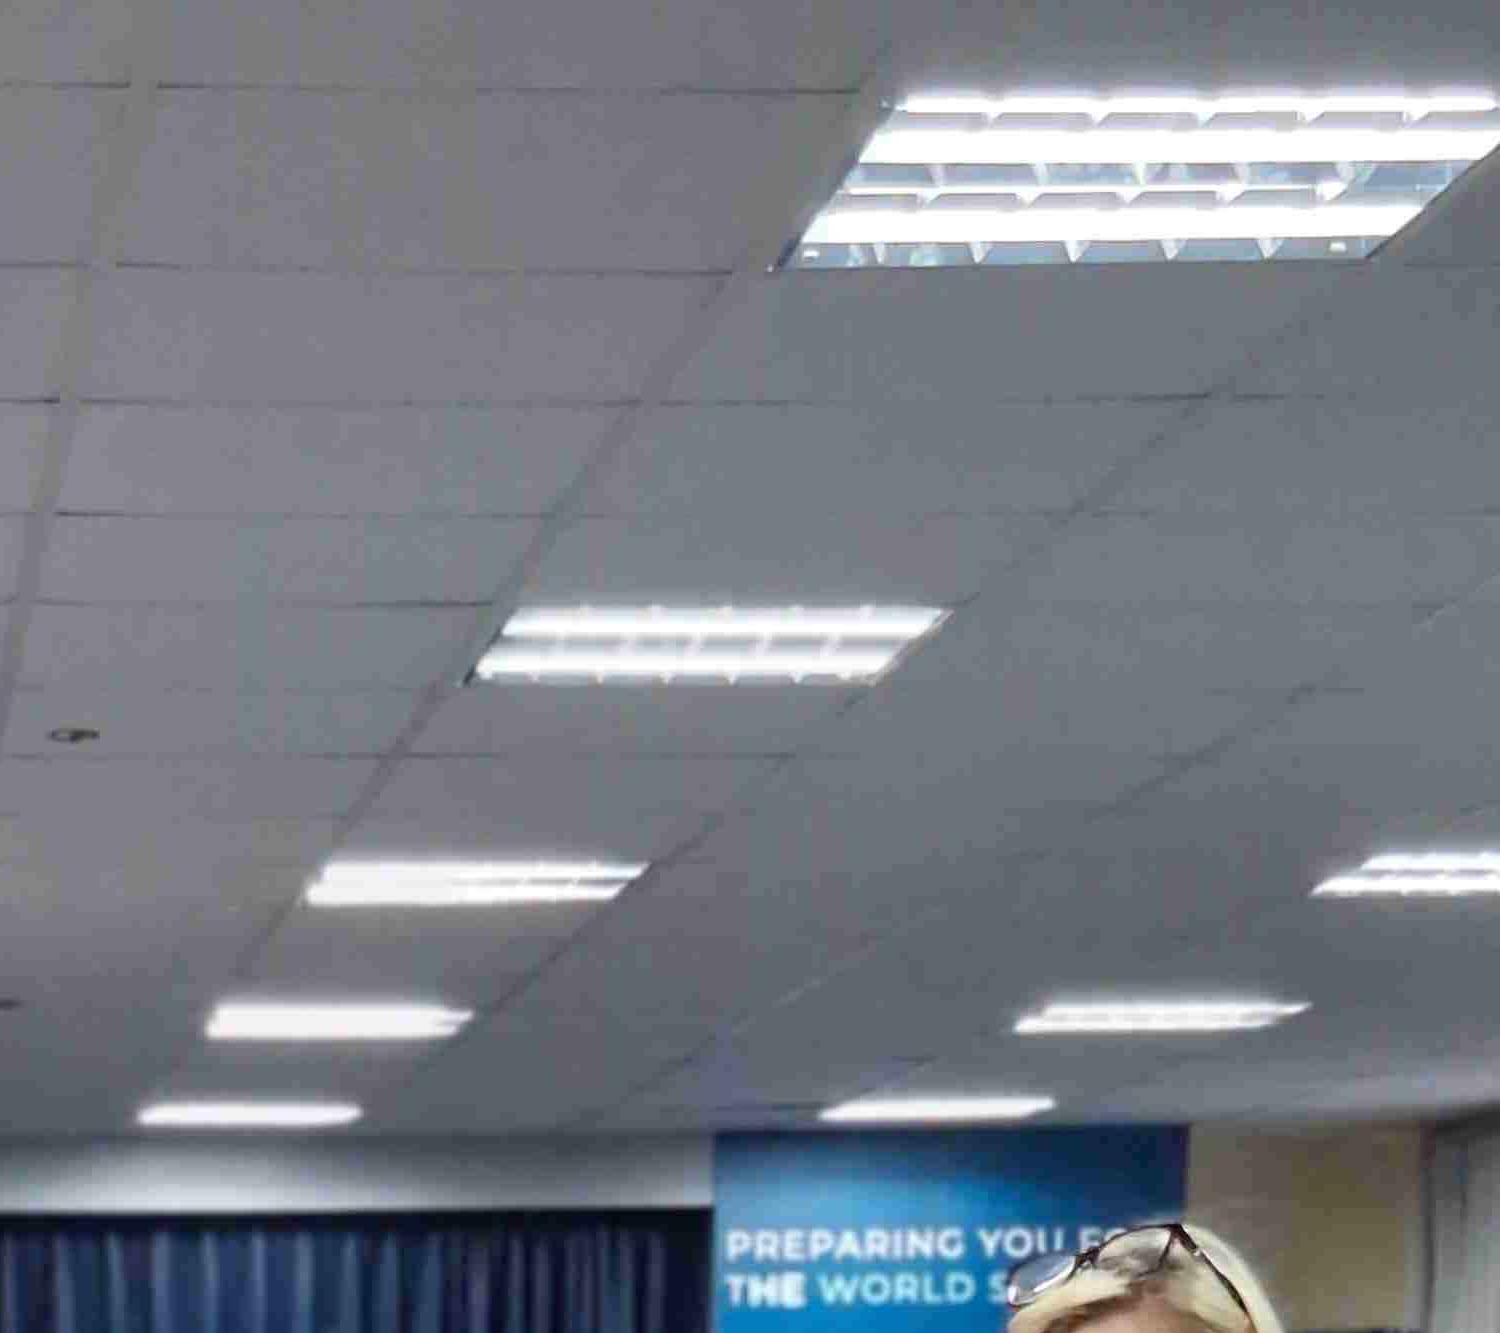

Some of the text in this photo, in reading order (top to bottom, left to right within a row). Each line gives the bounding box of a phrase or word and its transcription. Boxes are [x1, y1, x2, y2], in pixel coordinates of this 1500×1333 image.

[726, 1226, 1128, 1262] PREPARING YOU F
[727, 1273, 806, 1308] THE
[818, 1272, 975, 1305] WORLD
